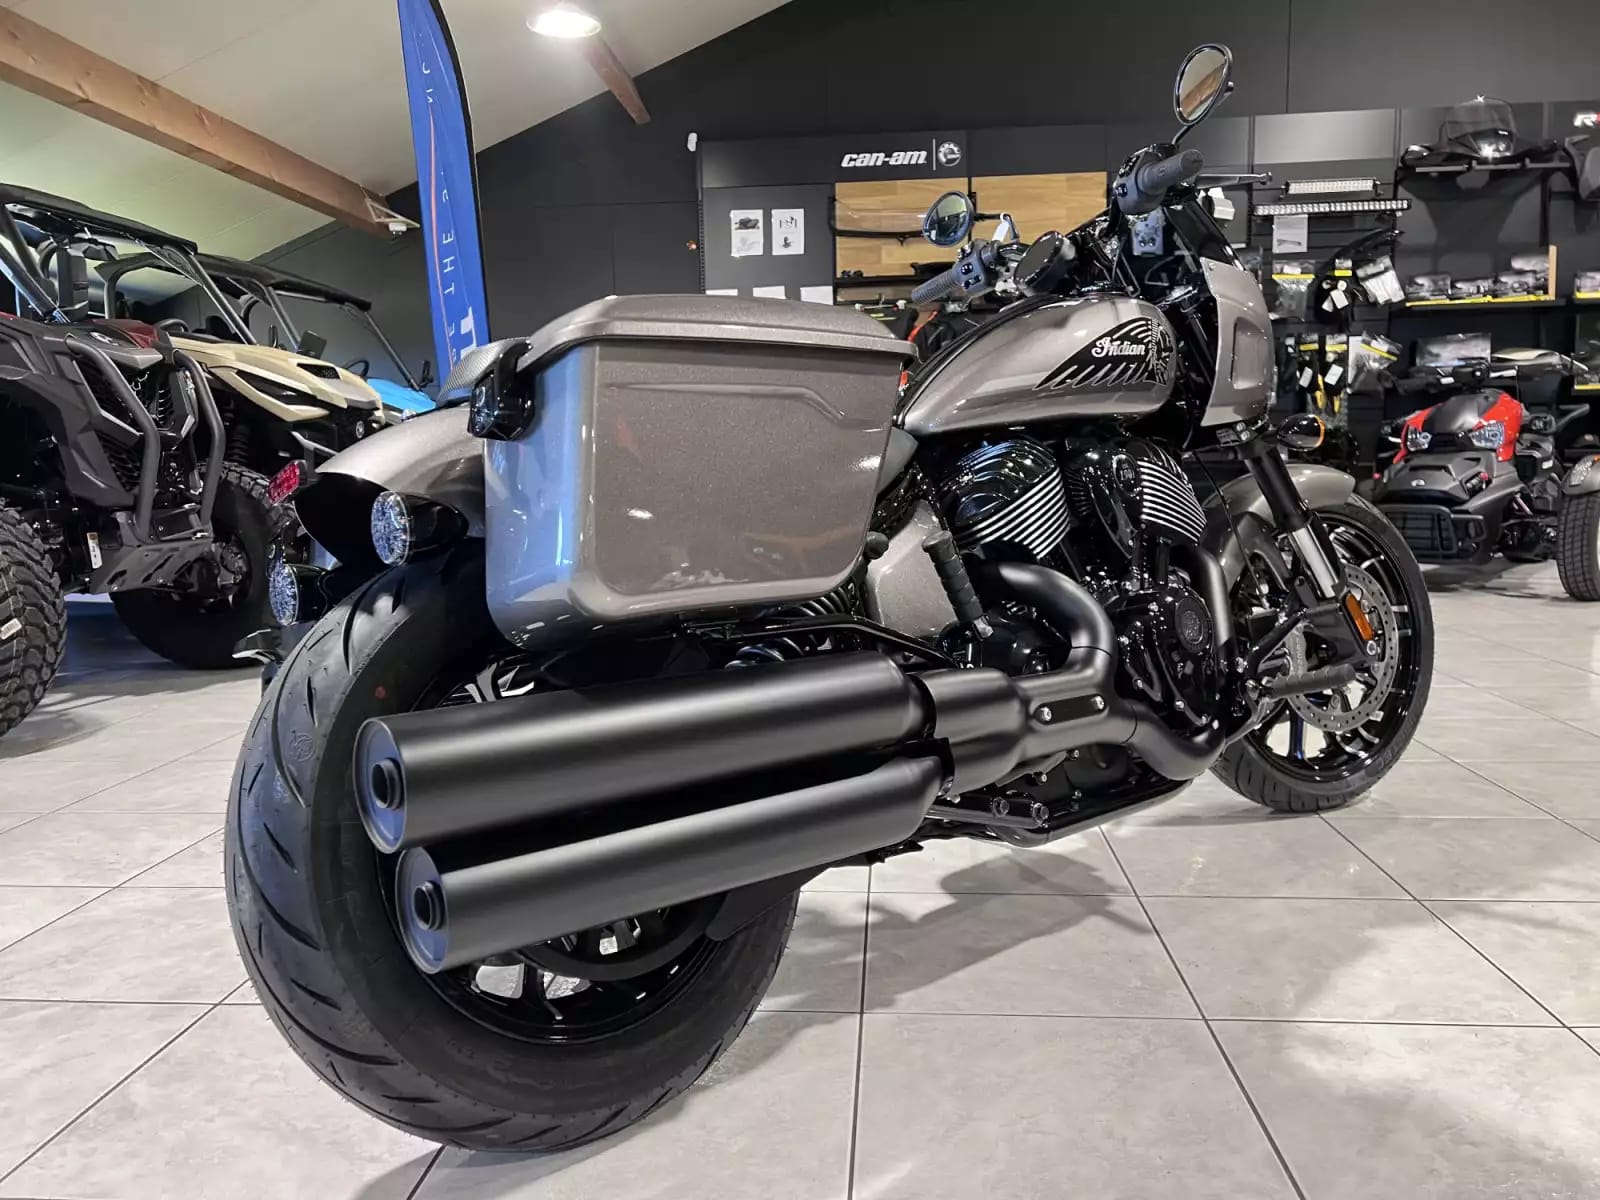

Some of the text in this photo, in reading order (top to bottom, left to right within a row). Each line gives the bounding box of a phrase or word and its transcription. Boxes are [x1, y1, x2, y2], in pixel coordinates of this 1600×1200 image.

[1573, 112, 1600, 127] R
[841, 150, 927, 168] can-am
[1091, 336, 1146, 358] Indian
